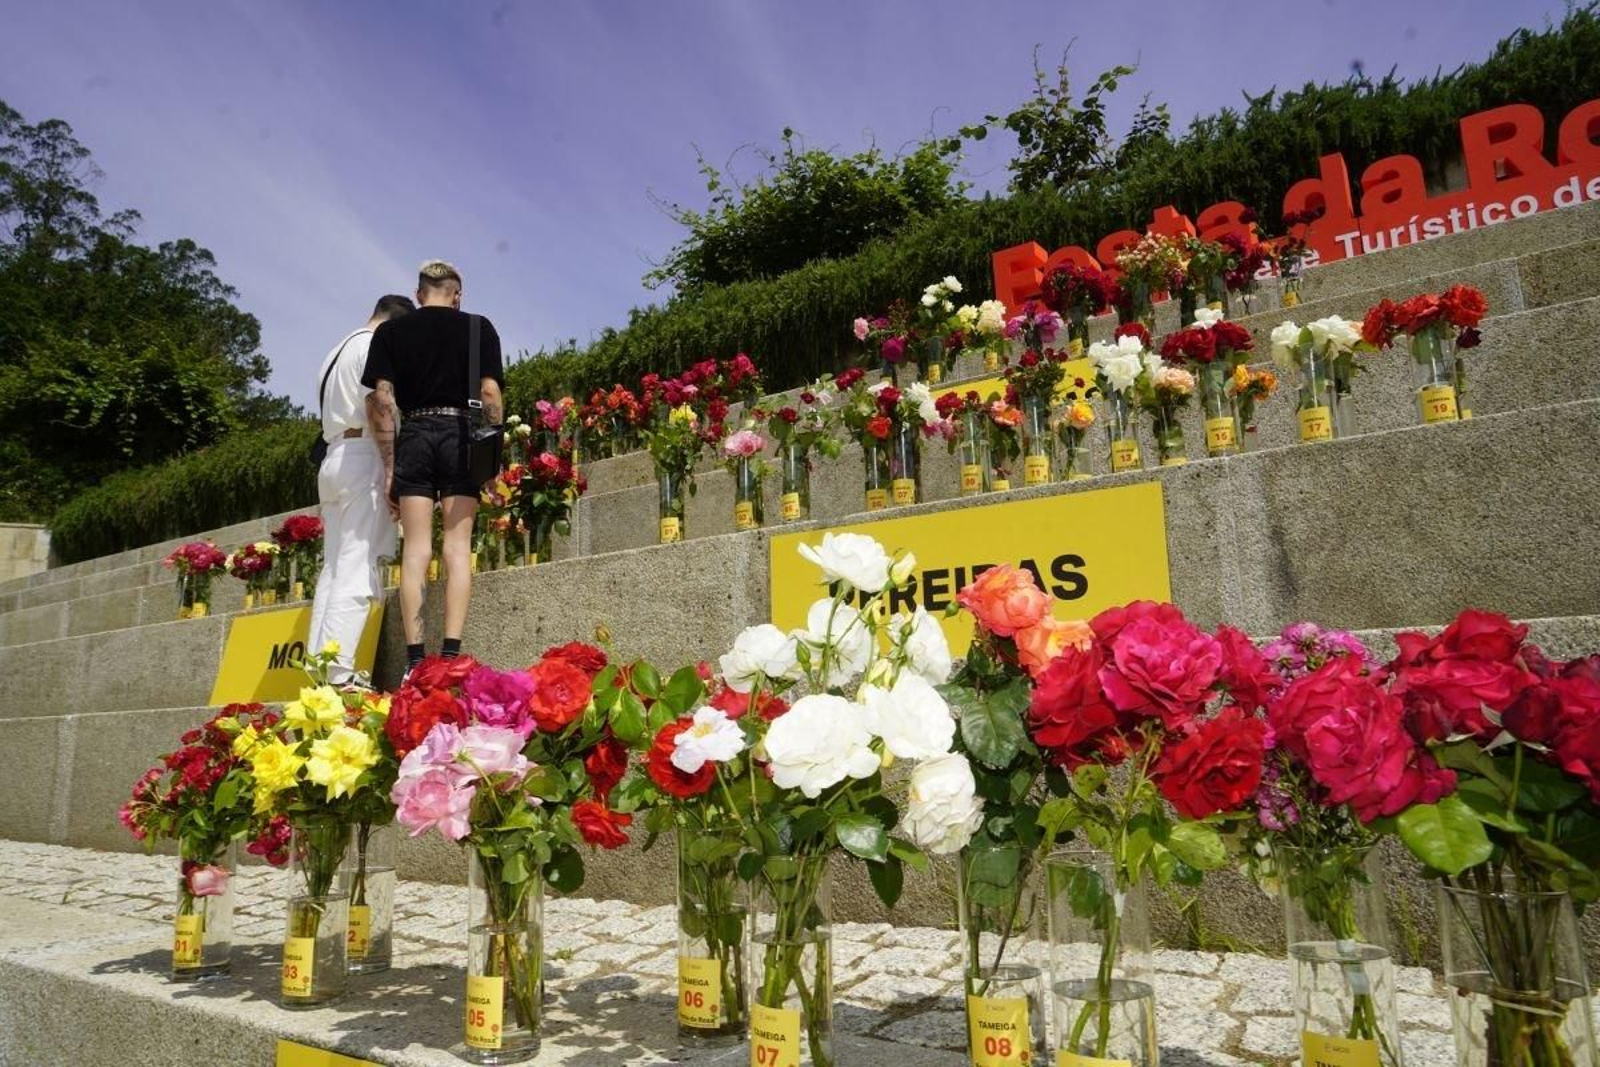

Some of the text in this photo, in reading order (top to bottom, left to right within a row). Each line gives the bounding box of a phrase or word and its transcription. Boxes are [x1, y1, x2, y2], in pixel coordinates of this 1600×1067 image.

[1282, 152, 1428, 243] da
[1335, 194, 1539, 259] Turístico
[828, 553, 1089, 618] EREIAS
[268, 640, 311, 670] MO
[175, 939, 187, 952] 01
[347, 930, 357, 943] 2
[284, 965, 298, 979] 03
[684, 990, 704, 1008] 06
[469, 1008, 485, 1028] 05
[978, 1020, 1017, 1031] TAMEIGA
[753, 1026, 787, 1042] TAMEIGA
[756, 1044, 780, 1067] 07
[984, 1036, 1012, 1057] 08
